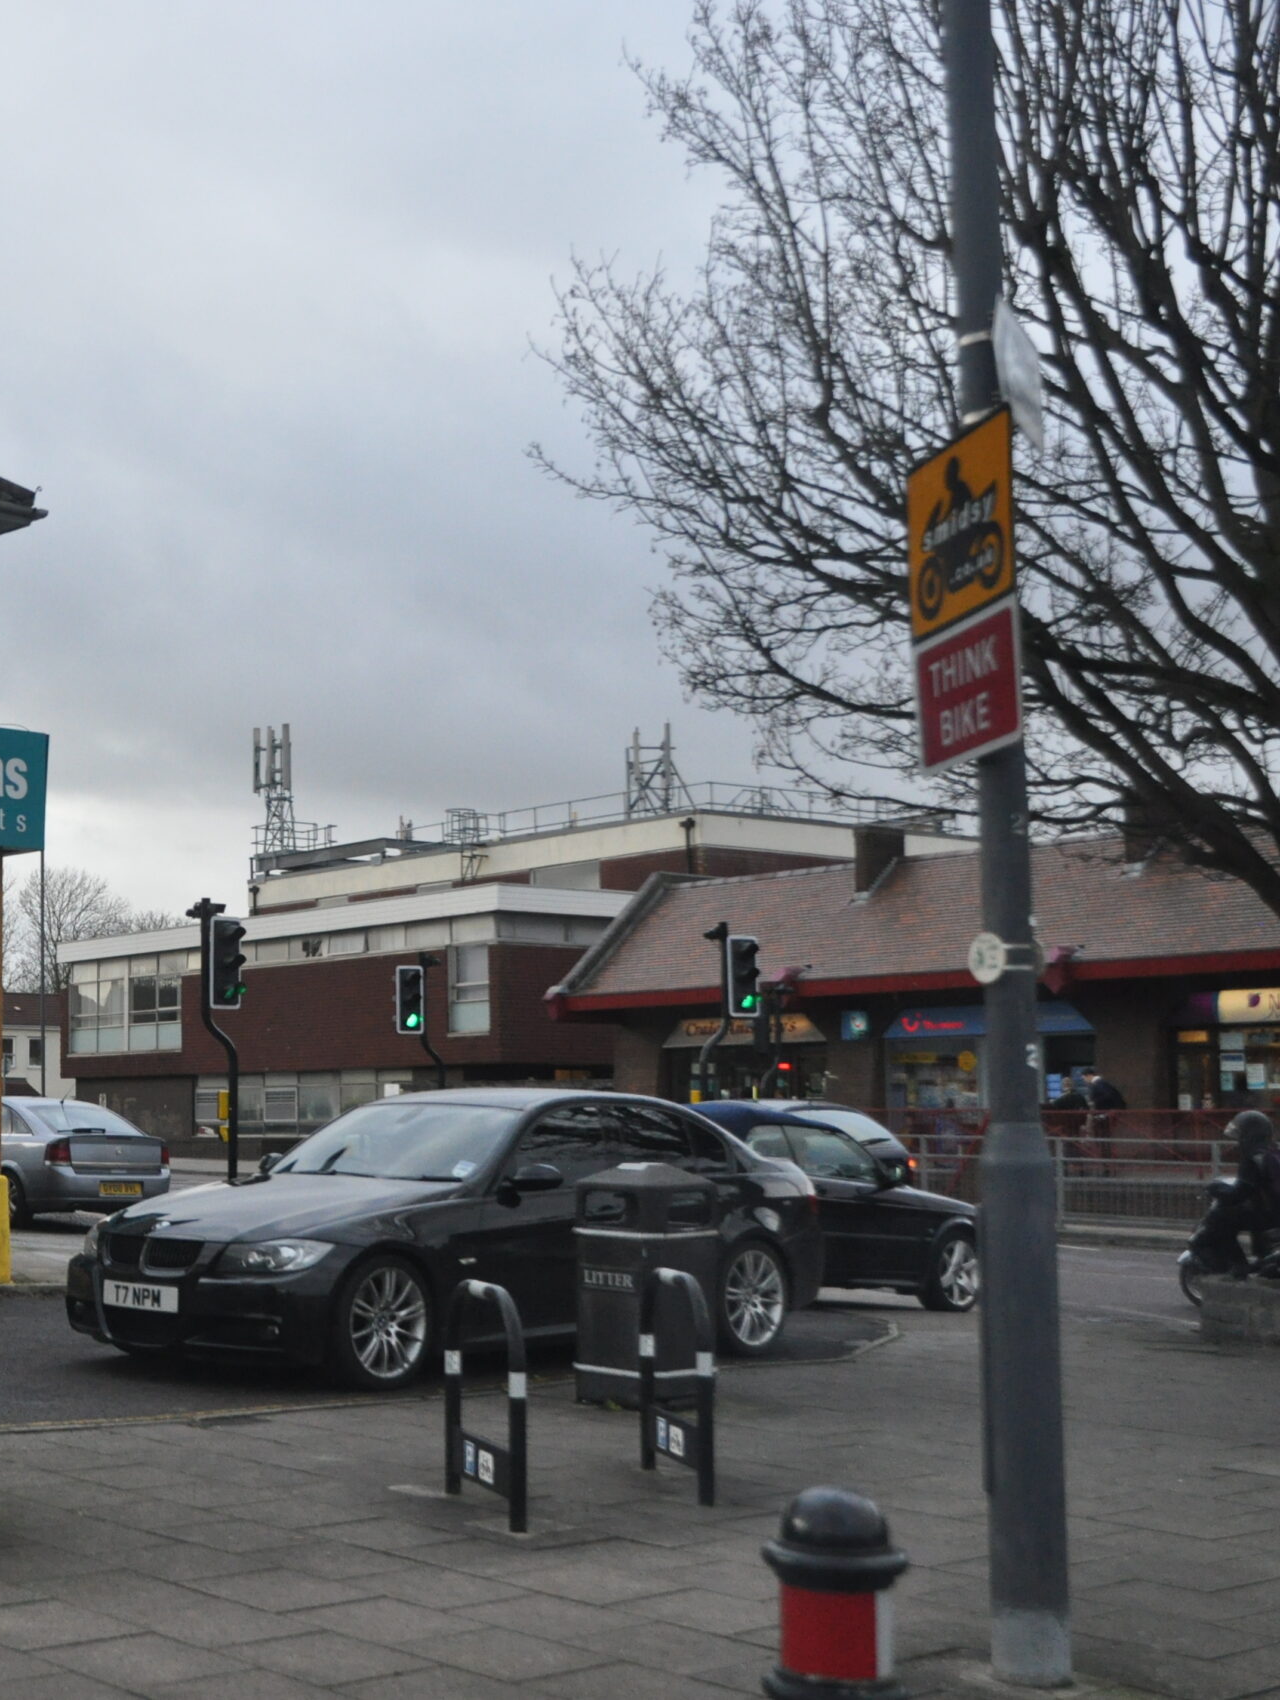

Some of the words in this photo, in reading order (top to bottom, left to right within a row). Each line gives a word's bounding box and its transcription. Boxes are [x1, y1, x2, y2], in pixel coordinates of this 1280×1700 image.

[922, 493, 994, 552] smidsy
[929, 634, 998, 698] THINK
[939, 692, 991, 747] BIKE
[114, 1284, 129, 1304] T7
[132, 1287, 162, 1308] NPM
[584, 1269, 634, 1289] LITTER
